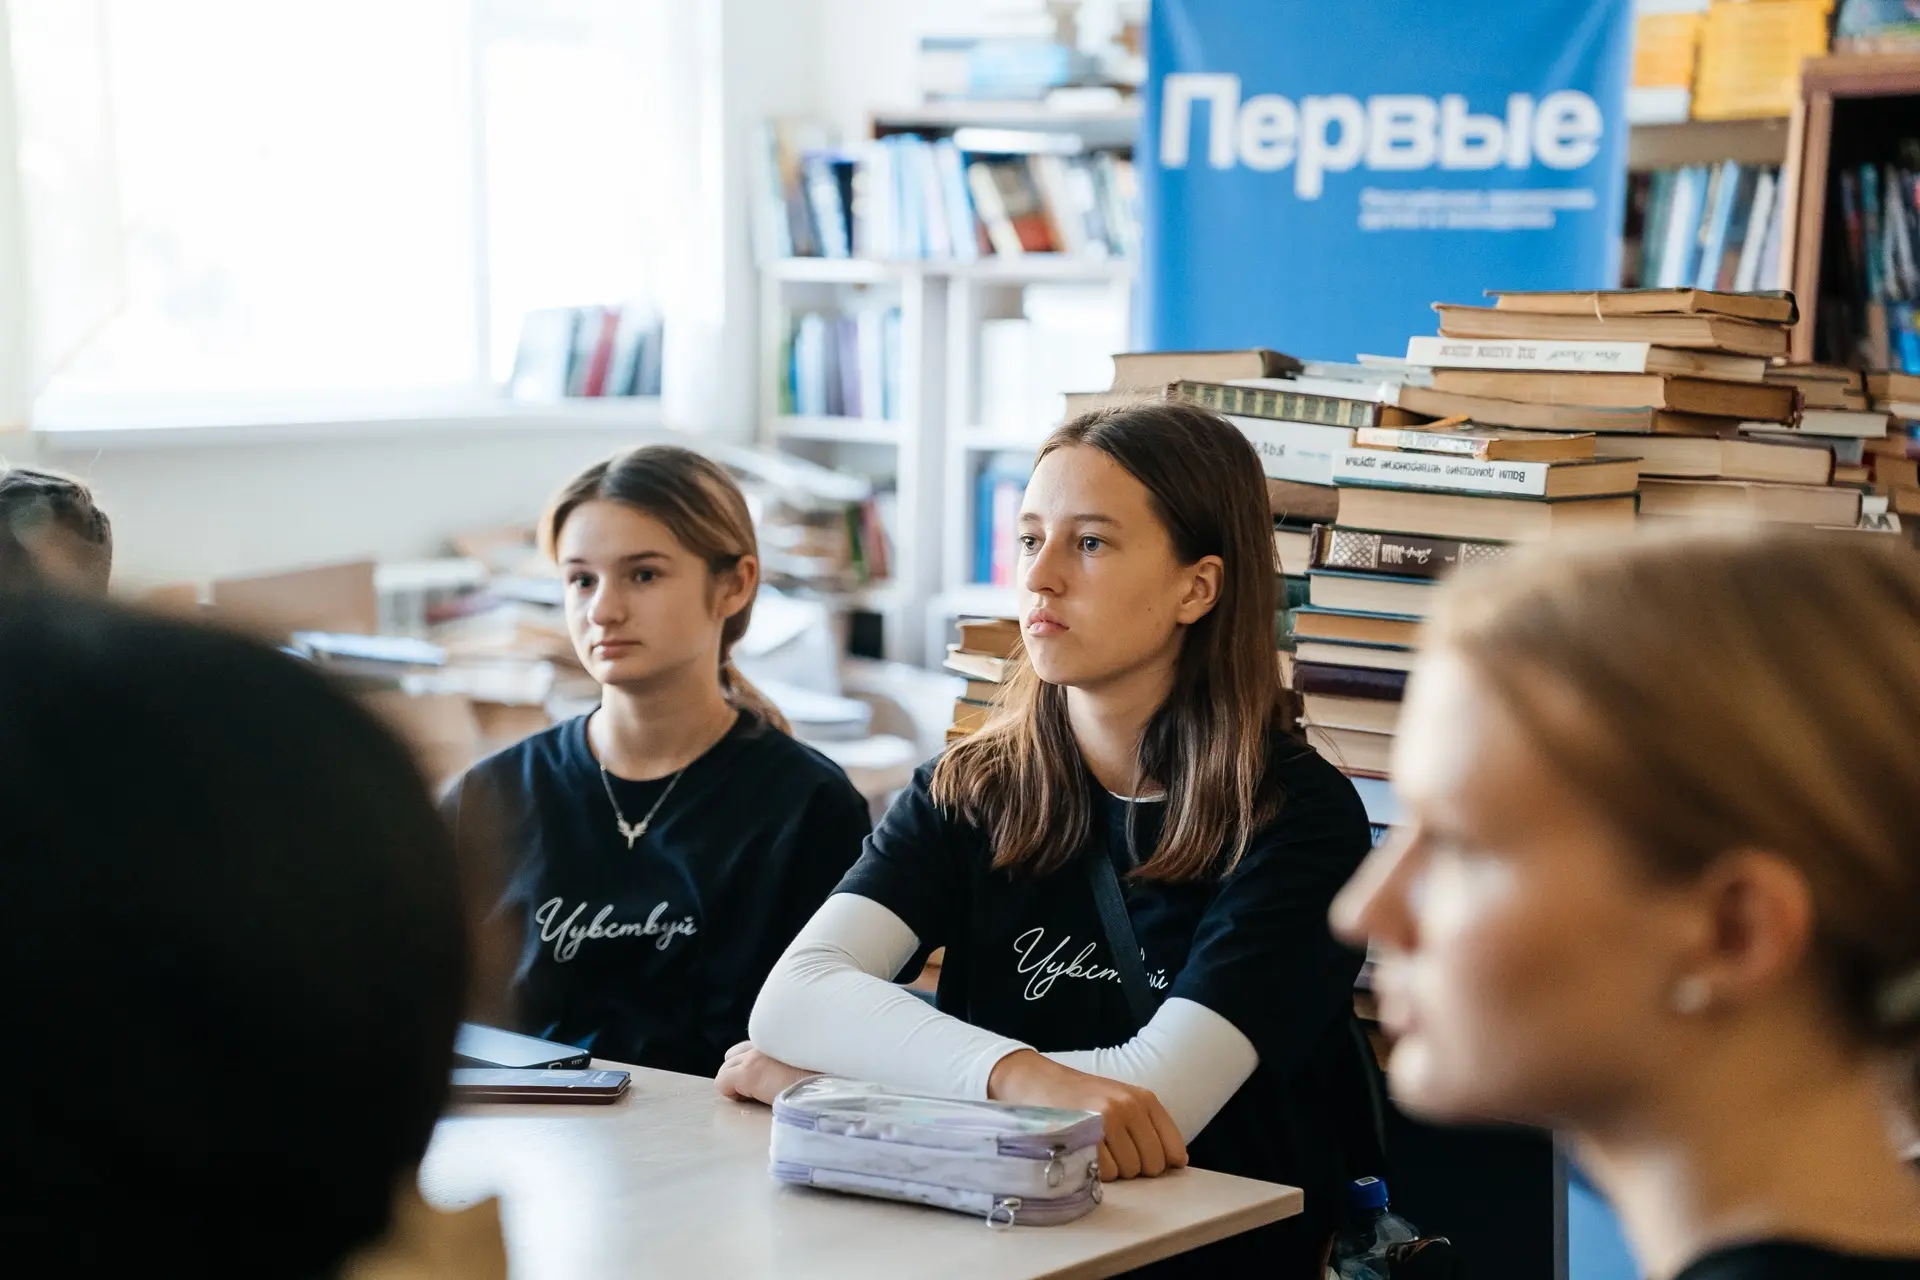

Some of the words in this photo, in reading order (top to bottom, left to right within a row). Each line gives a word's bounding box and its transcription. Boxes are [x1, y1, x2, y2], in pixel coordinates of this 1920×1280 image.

[1161, 73, 1602, 200] Первые
[535, 897, 697, 962] Чувствуй
[1014, 927, 1169, 1001] Чувстй
